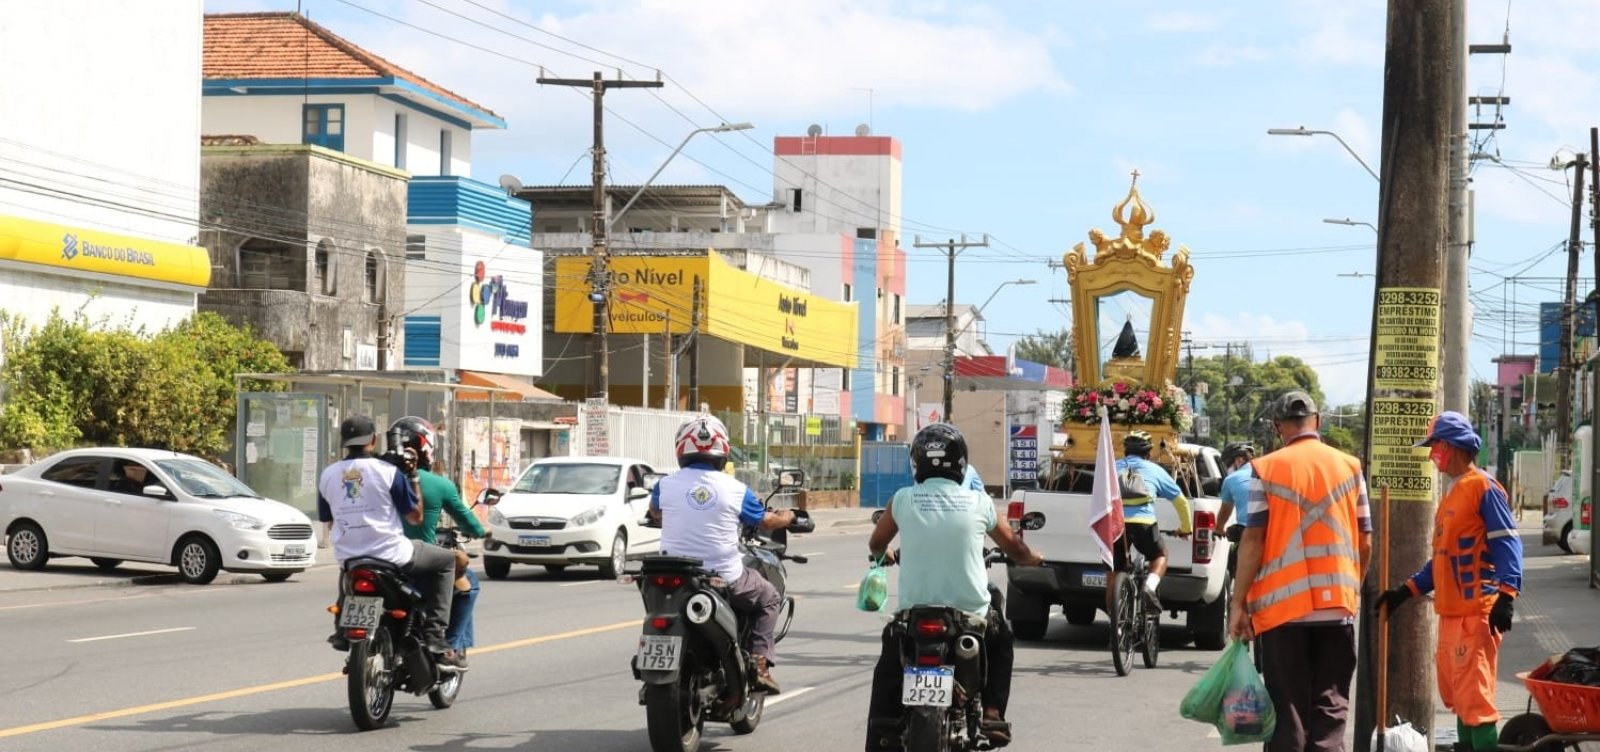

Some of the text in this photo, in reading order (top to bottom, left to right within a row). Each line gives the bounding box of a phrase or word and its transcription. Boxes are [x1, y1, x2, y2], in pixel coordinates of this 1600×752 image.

[82, 241, 155, 266] BANCO DO BRASIL
[635, 268, 683, 286] Nível
[1380, 292, 1438, 304] 3298-3252
[1381, 366, 1436, 379] 99382-8256
[1374, 402, 1433, 415] 3298-3252
[347, 603, 377, 617] PKG
[343, 615, 376, 628] 3322
[643, 643, 676, 657] JSN
[642, 656, 675, 669] 1757
[915, 674, 942, 688] PLU
[909, 688, 946, 703] 2F22
